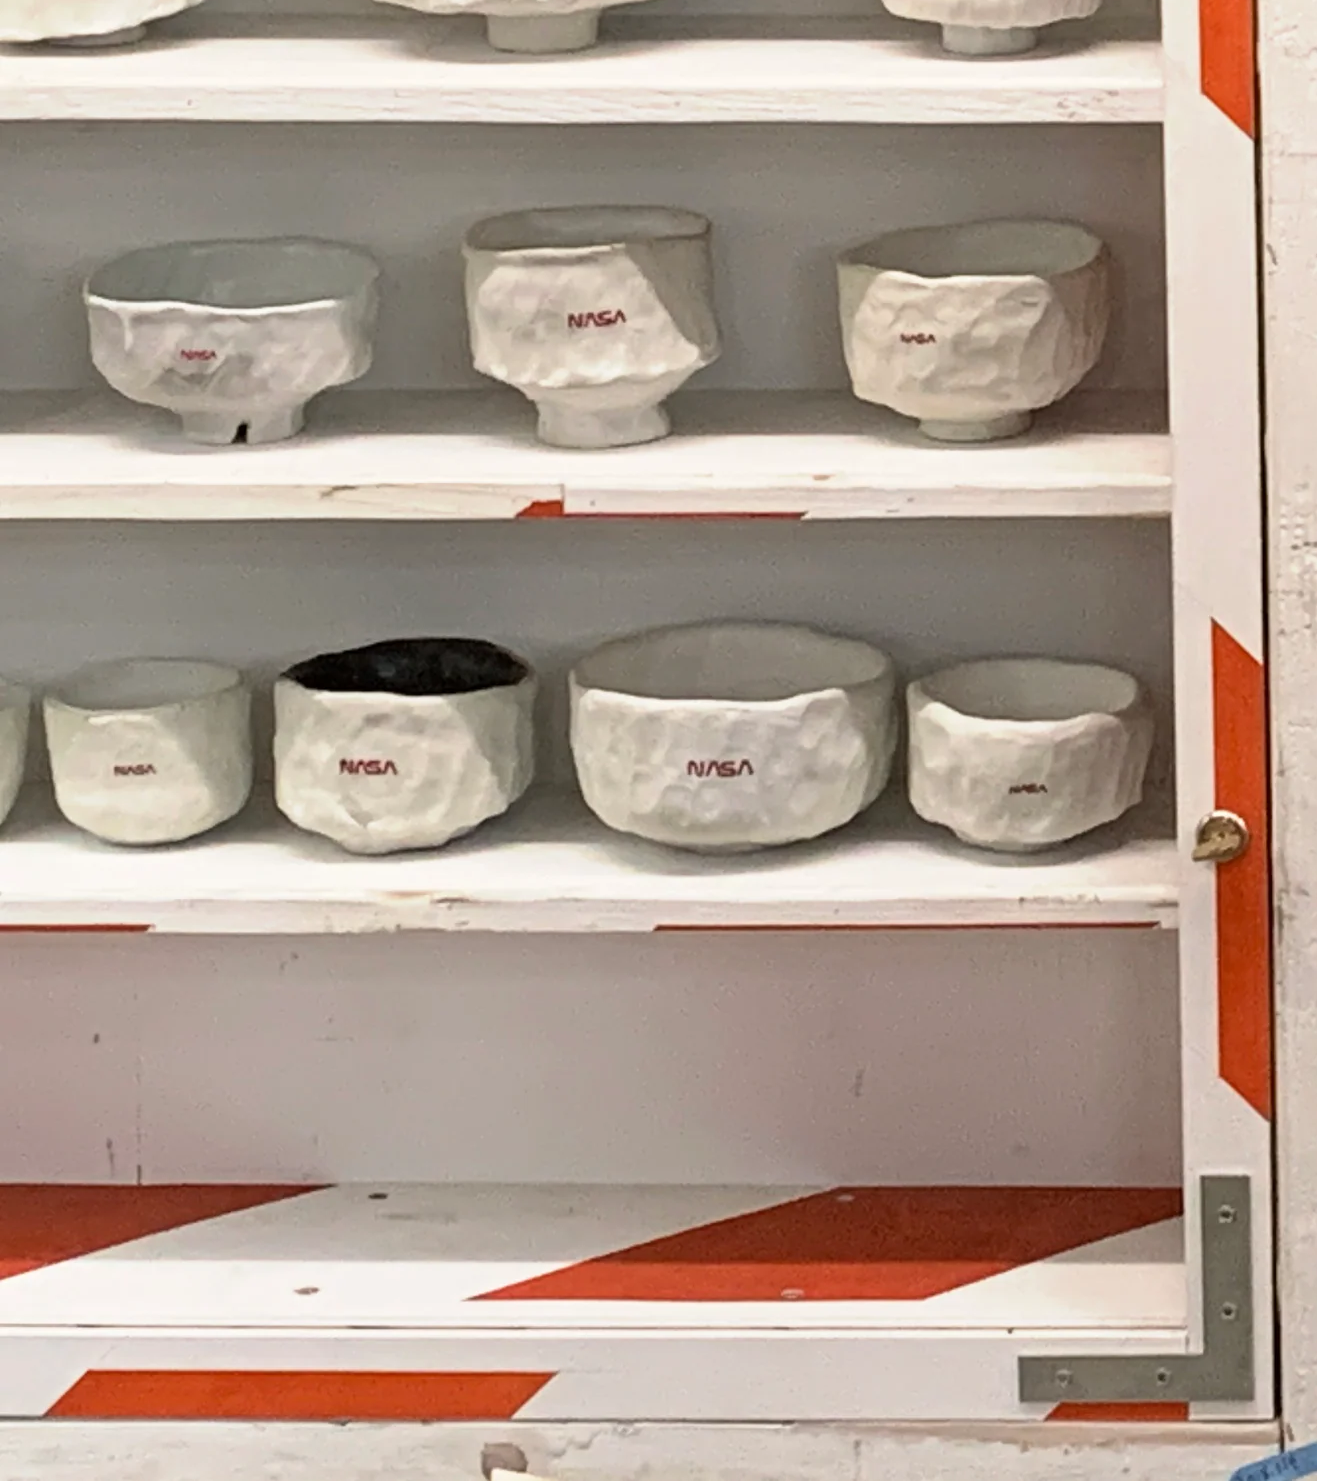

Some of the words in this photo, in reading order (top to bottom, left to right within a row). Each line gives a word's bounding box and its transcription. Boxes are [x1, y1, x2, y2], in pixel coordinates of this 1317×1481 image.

[567, 309, 627, 329] NASA
[899, 332, 938, 345] NASA
[179, 349, 217, 361] NASA
[113, 763, 157, 777] NASA
[338, 758, 399, 776] NASA
[686, 758, 755, 778] NASA
